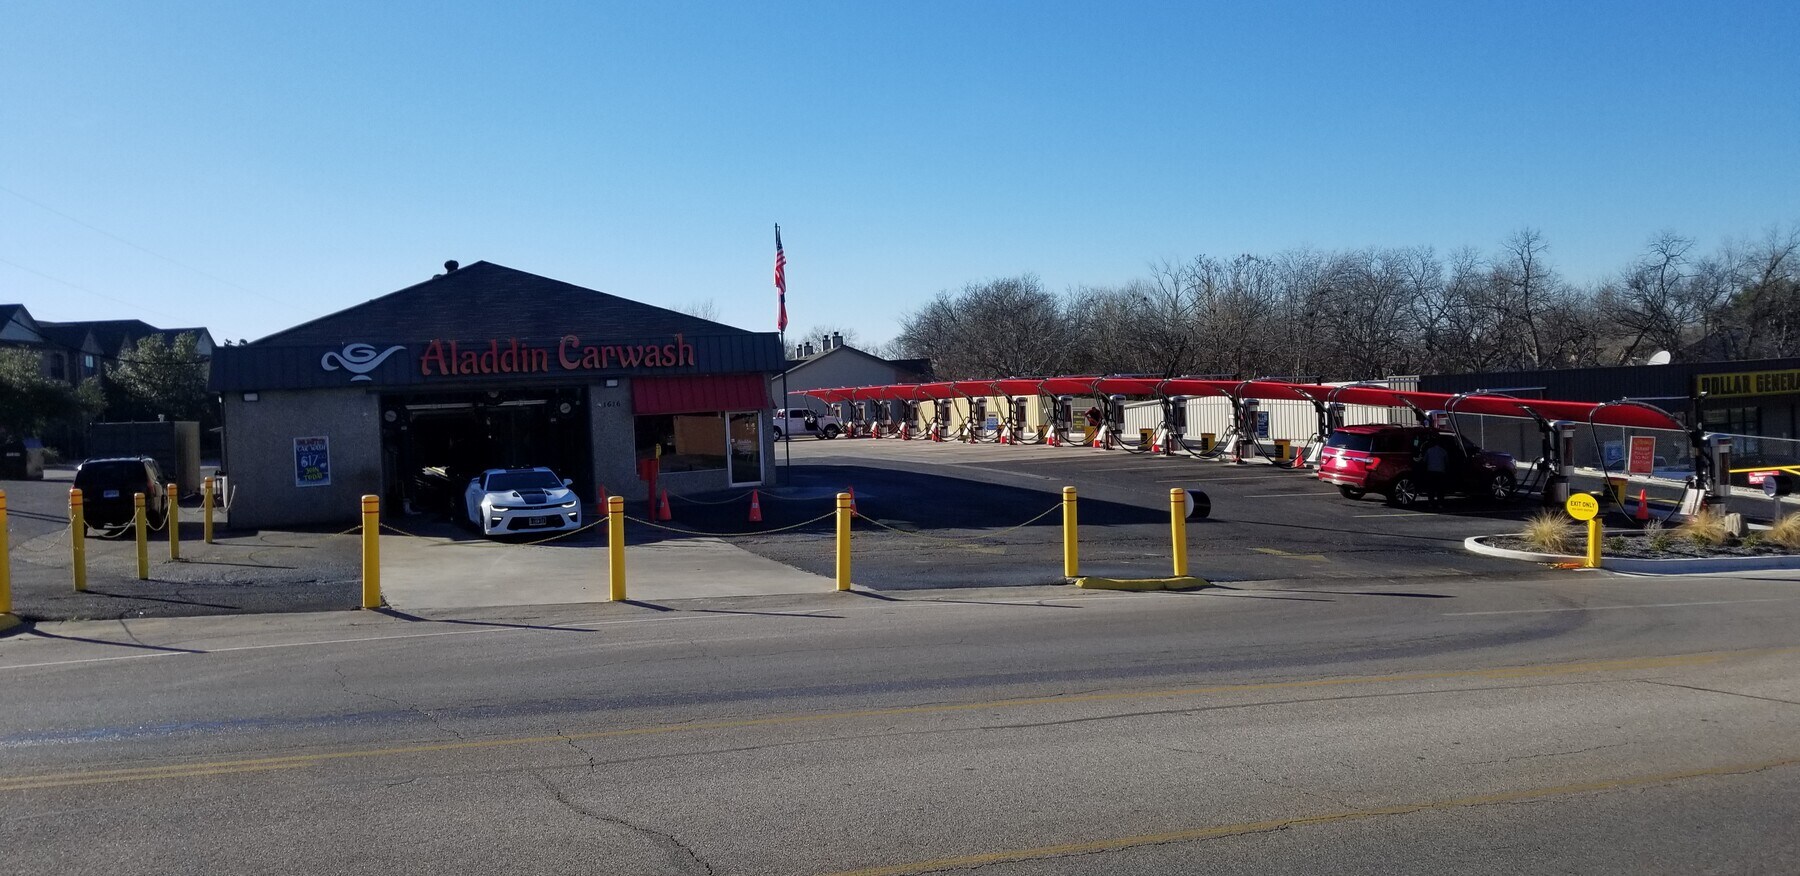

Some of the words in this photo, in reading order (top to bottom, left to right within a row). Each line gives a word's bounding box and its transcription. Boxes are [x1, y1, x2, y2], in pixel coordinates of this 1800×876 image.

[421, 338, 548, 375] Aladdin
[559, 334, 694, 369] Carwash
[1701, 376, 1752, 396] DOLLAR
[1582, 501, 1596, 509] ONLY
